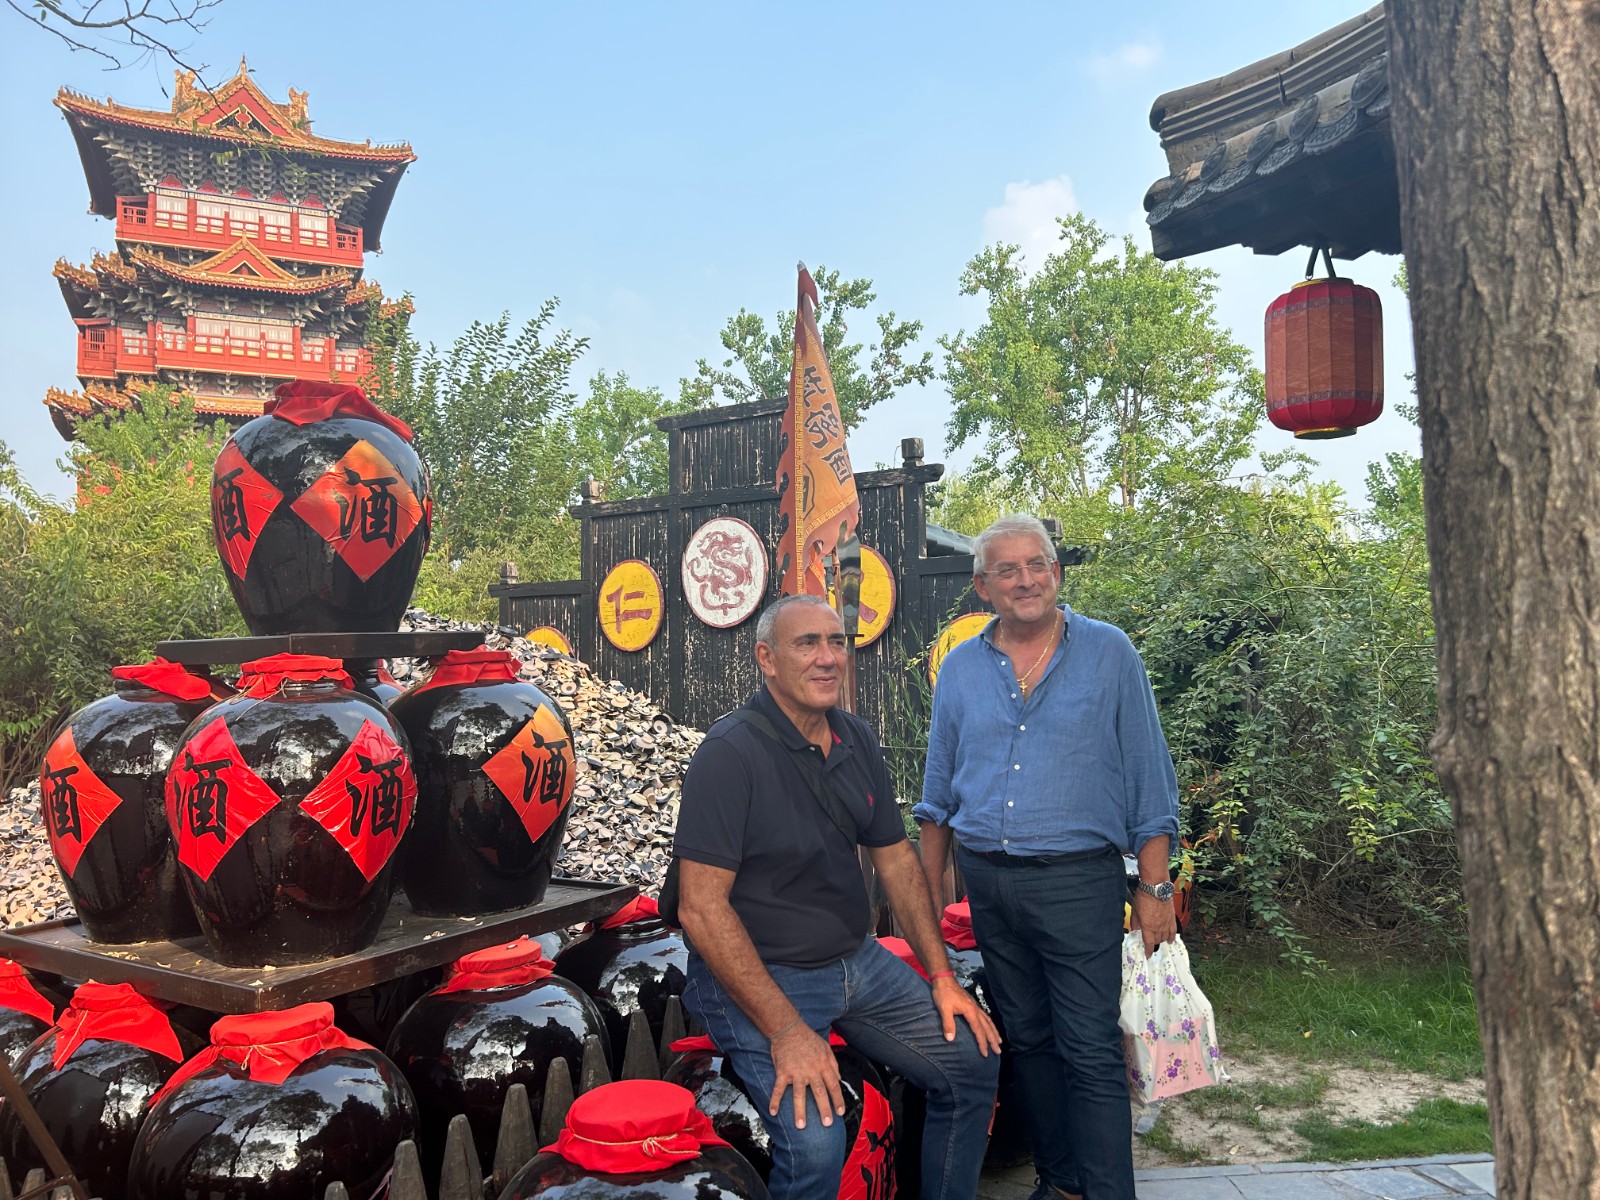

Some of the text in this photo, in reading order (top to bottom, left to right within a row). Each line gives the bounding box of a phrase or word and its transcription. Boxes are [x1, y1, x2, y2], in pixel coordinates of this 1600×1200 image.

[213, 467, 250, 543] 酒
[333, 466, 398, 549] 酒
[606, 584, 652, 634] 仁
[44, 758, 82, 844] 酒
[174, 752, 233, 845] 酒
[345, 752, 403, 838] 酒
[521, 728, 568, 807] 酒
